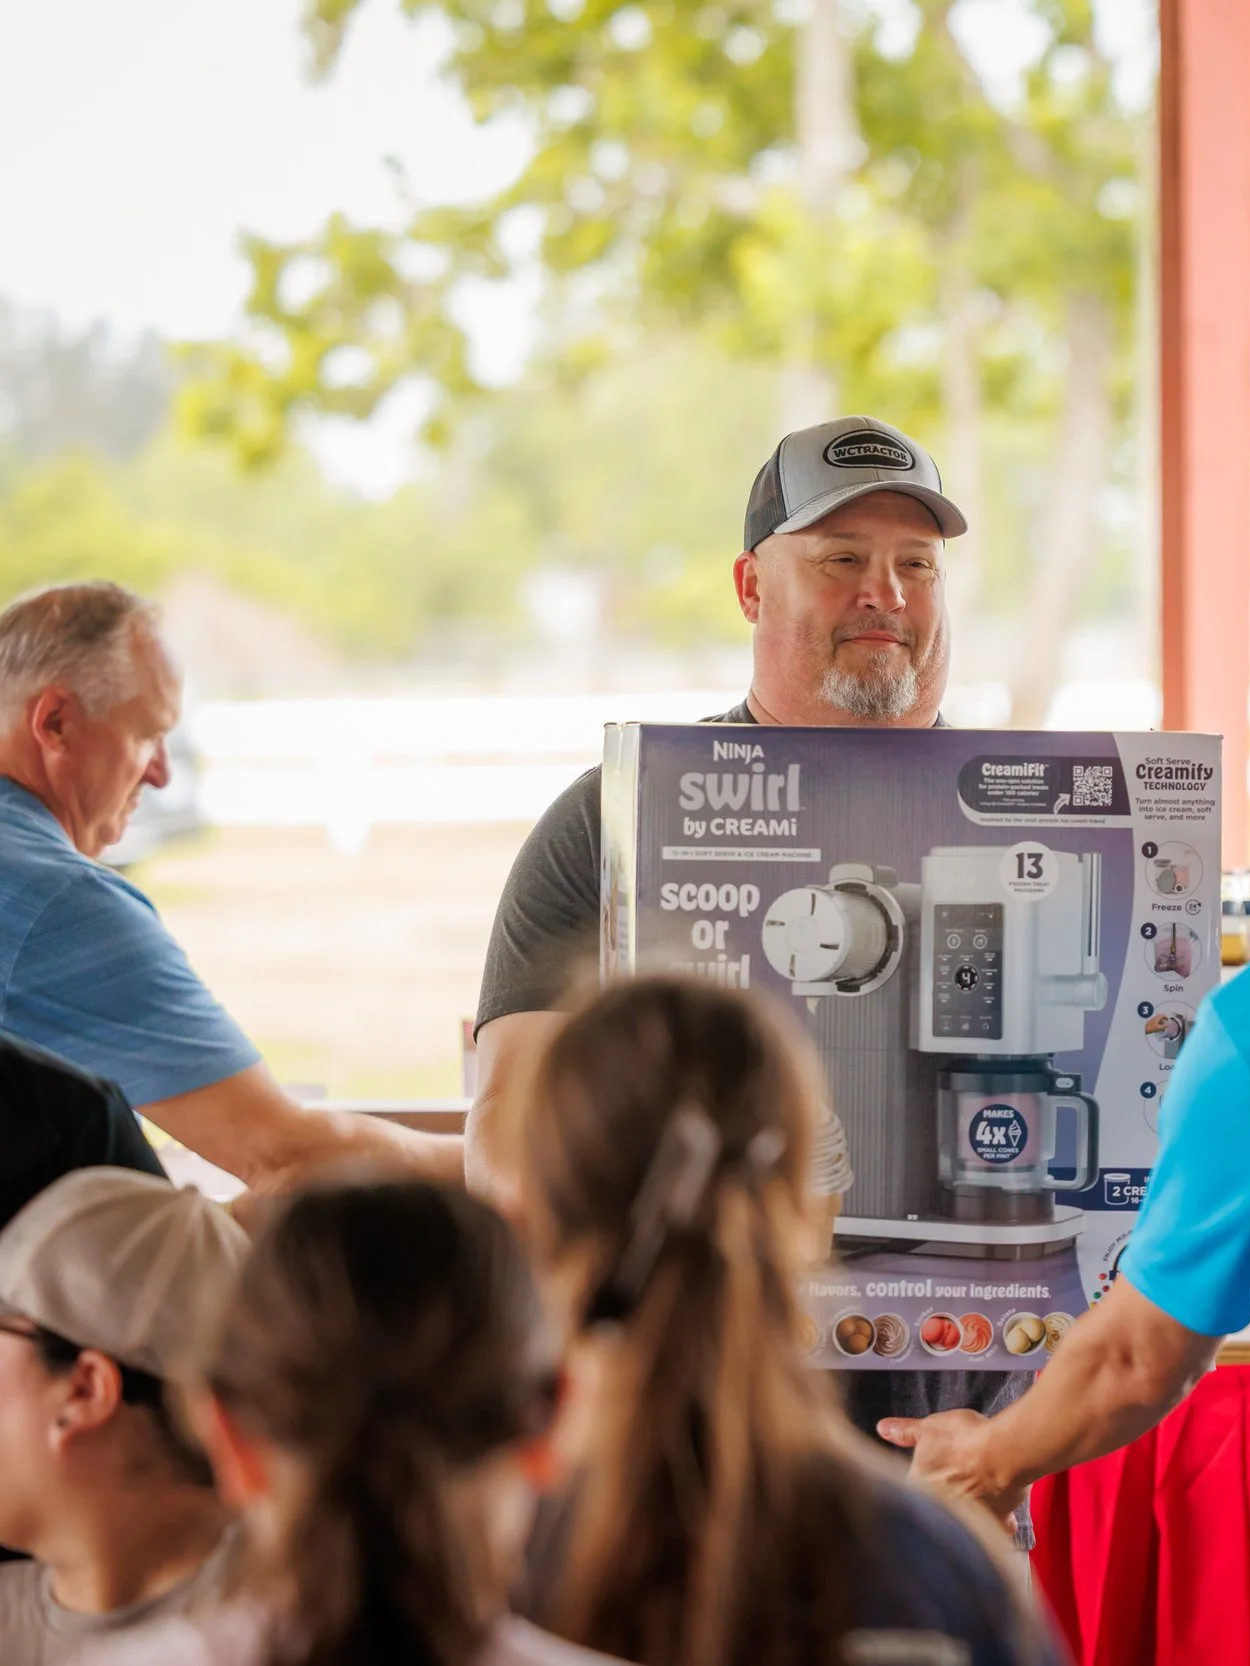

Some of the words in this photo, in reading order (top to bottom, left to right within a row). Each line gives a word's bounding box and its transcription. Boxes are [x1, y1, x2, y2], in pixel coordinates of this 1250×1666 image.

[833, 446, 908, 461] WCTRACTOR
[713, 740, 765, 764] NINJA
[1145, 757, 1164, 765] Soft
[1166, 757, 1192, 766] Serve
[982, 763, 1045, 777] CreamiFit
[1135, 763, 1214, 780] Creamify
[679, 762, 801, 812] swirl
[1144, 781, 1207, 791] TECHNOLOGY
[1135, 797, 1152, 805] Turn
[1182, 798, 1216, 807] anything
[1138, 805, 1154, 813] into
[1155, 805, 1167, 813] ice
[1168, 806, 1194, 814] cream,
[1169, 813, 1184, 821] and
[683, 817, 706, 839] by
[710, 818, 797, 836] CREAMi
[1147, 846, 1152, 855] 1
[1016, 852, 1044, 879] 13
[660, 882, 761, 917] scoop
[1151, 903, 1182, 911] Freeze
[691, 919, 729, 949] or
[1145, 926, 1152, 936] 2
[671, 953, 750, 989] wirl
[1163, 984, 1184, 993] Spin
[1142, 1005, 1150, 1015] 3
[1144, 1086, 1152, 1095] 4
[983, 1109, 1015, 1119] MAKES
[975, 1121, 1008, 1145] 4x
[1112, 1186, 1121, 1197] 2
[1123, 1186, 1148, 1196] CRE
[866, 1279, 932, 1298] control
[935, 1285, 967, 1298] your
[970, 1283, 1052, 1300] ingredients.
